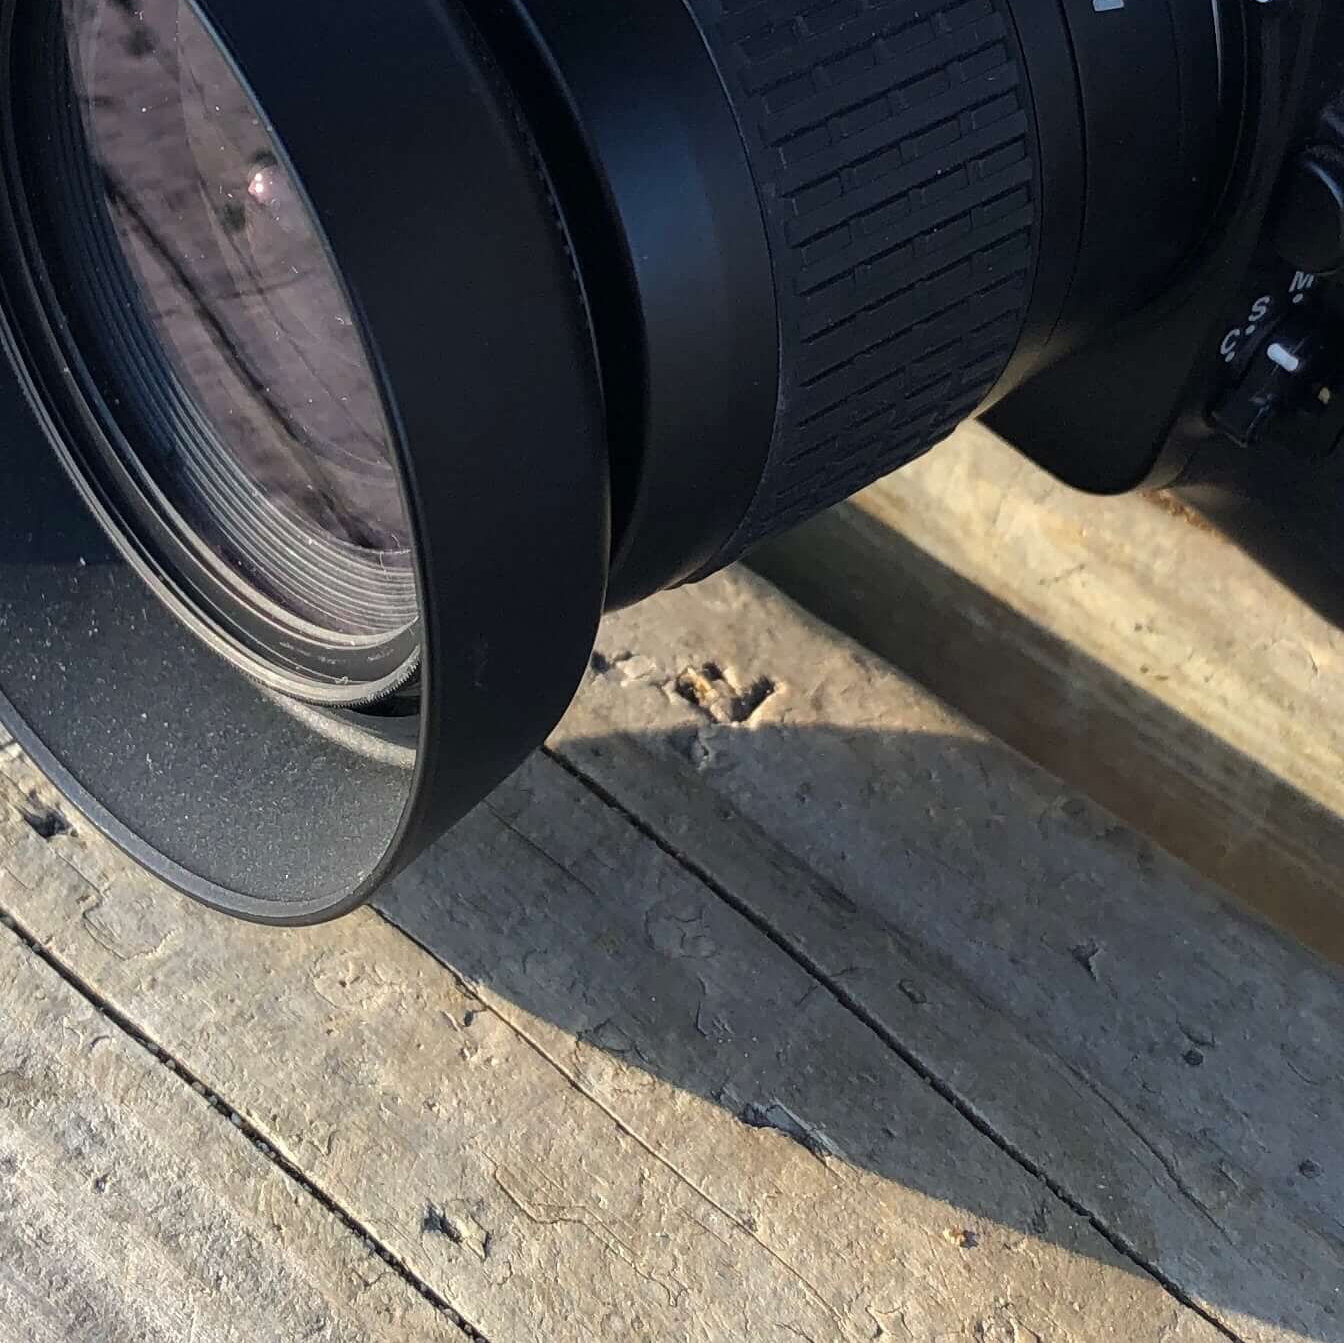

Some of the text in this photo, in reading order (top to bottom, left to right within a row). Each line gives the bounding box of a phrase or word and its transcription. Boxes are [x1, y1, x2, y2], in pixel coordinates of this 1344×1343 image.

[1288, 270, 1315, 293] M
[1248, 296, 1271, 322] S
[1220, 328, 1241, 355] C
